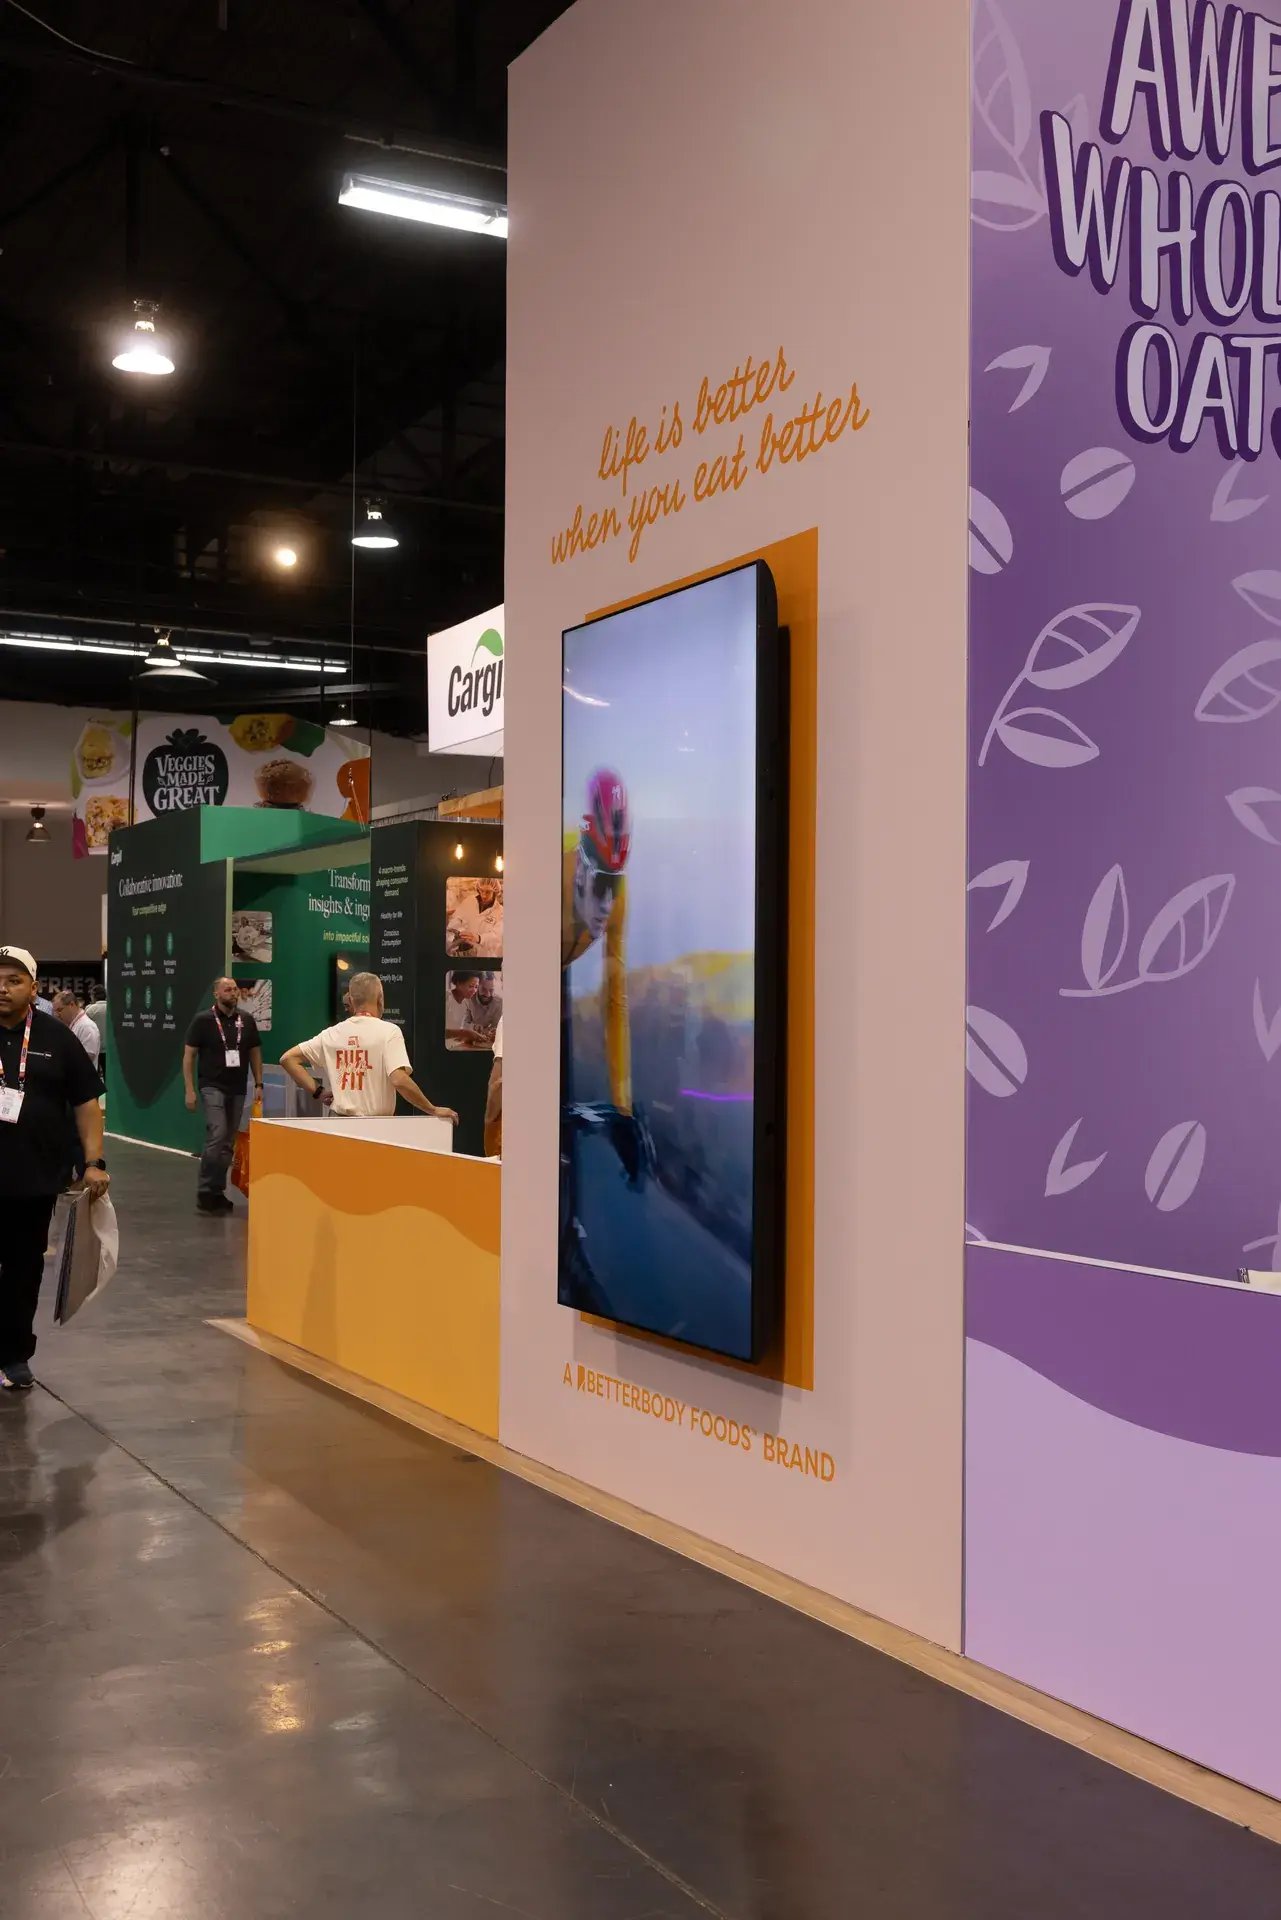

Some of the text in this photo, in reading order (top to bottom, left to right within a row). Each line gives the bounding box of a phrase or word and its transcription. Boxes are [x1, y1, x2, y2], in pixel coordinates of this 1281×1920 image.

[1115, 321, 1281, 461] OAT
[599, 346, 795, 496] life is better
[551, 382, 870, 564] when you eat better
[155, 754, 216, 776] VEGGIES
[166, 772, 206, 787] MADE
[153, 786, 220, 811] GREAT
[328, 869, 370, 891] Transform
[308, 894, 342, 918] insights
[344, 897, 353, 915] &
[323, 930, 334, 941] into
[335, 931, 361, 944] impactful
[336, 1050, 372, 1069] FUEL
[341, 1072, 364, 1090] FIT
[563, 1362, 573, 1387] A
[587, 1370, 685, 1426] BETTERBODY
[763, 1433, 836, 1482] BRAND
